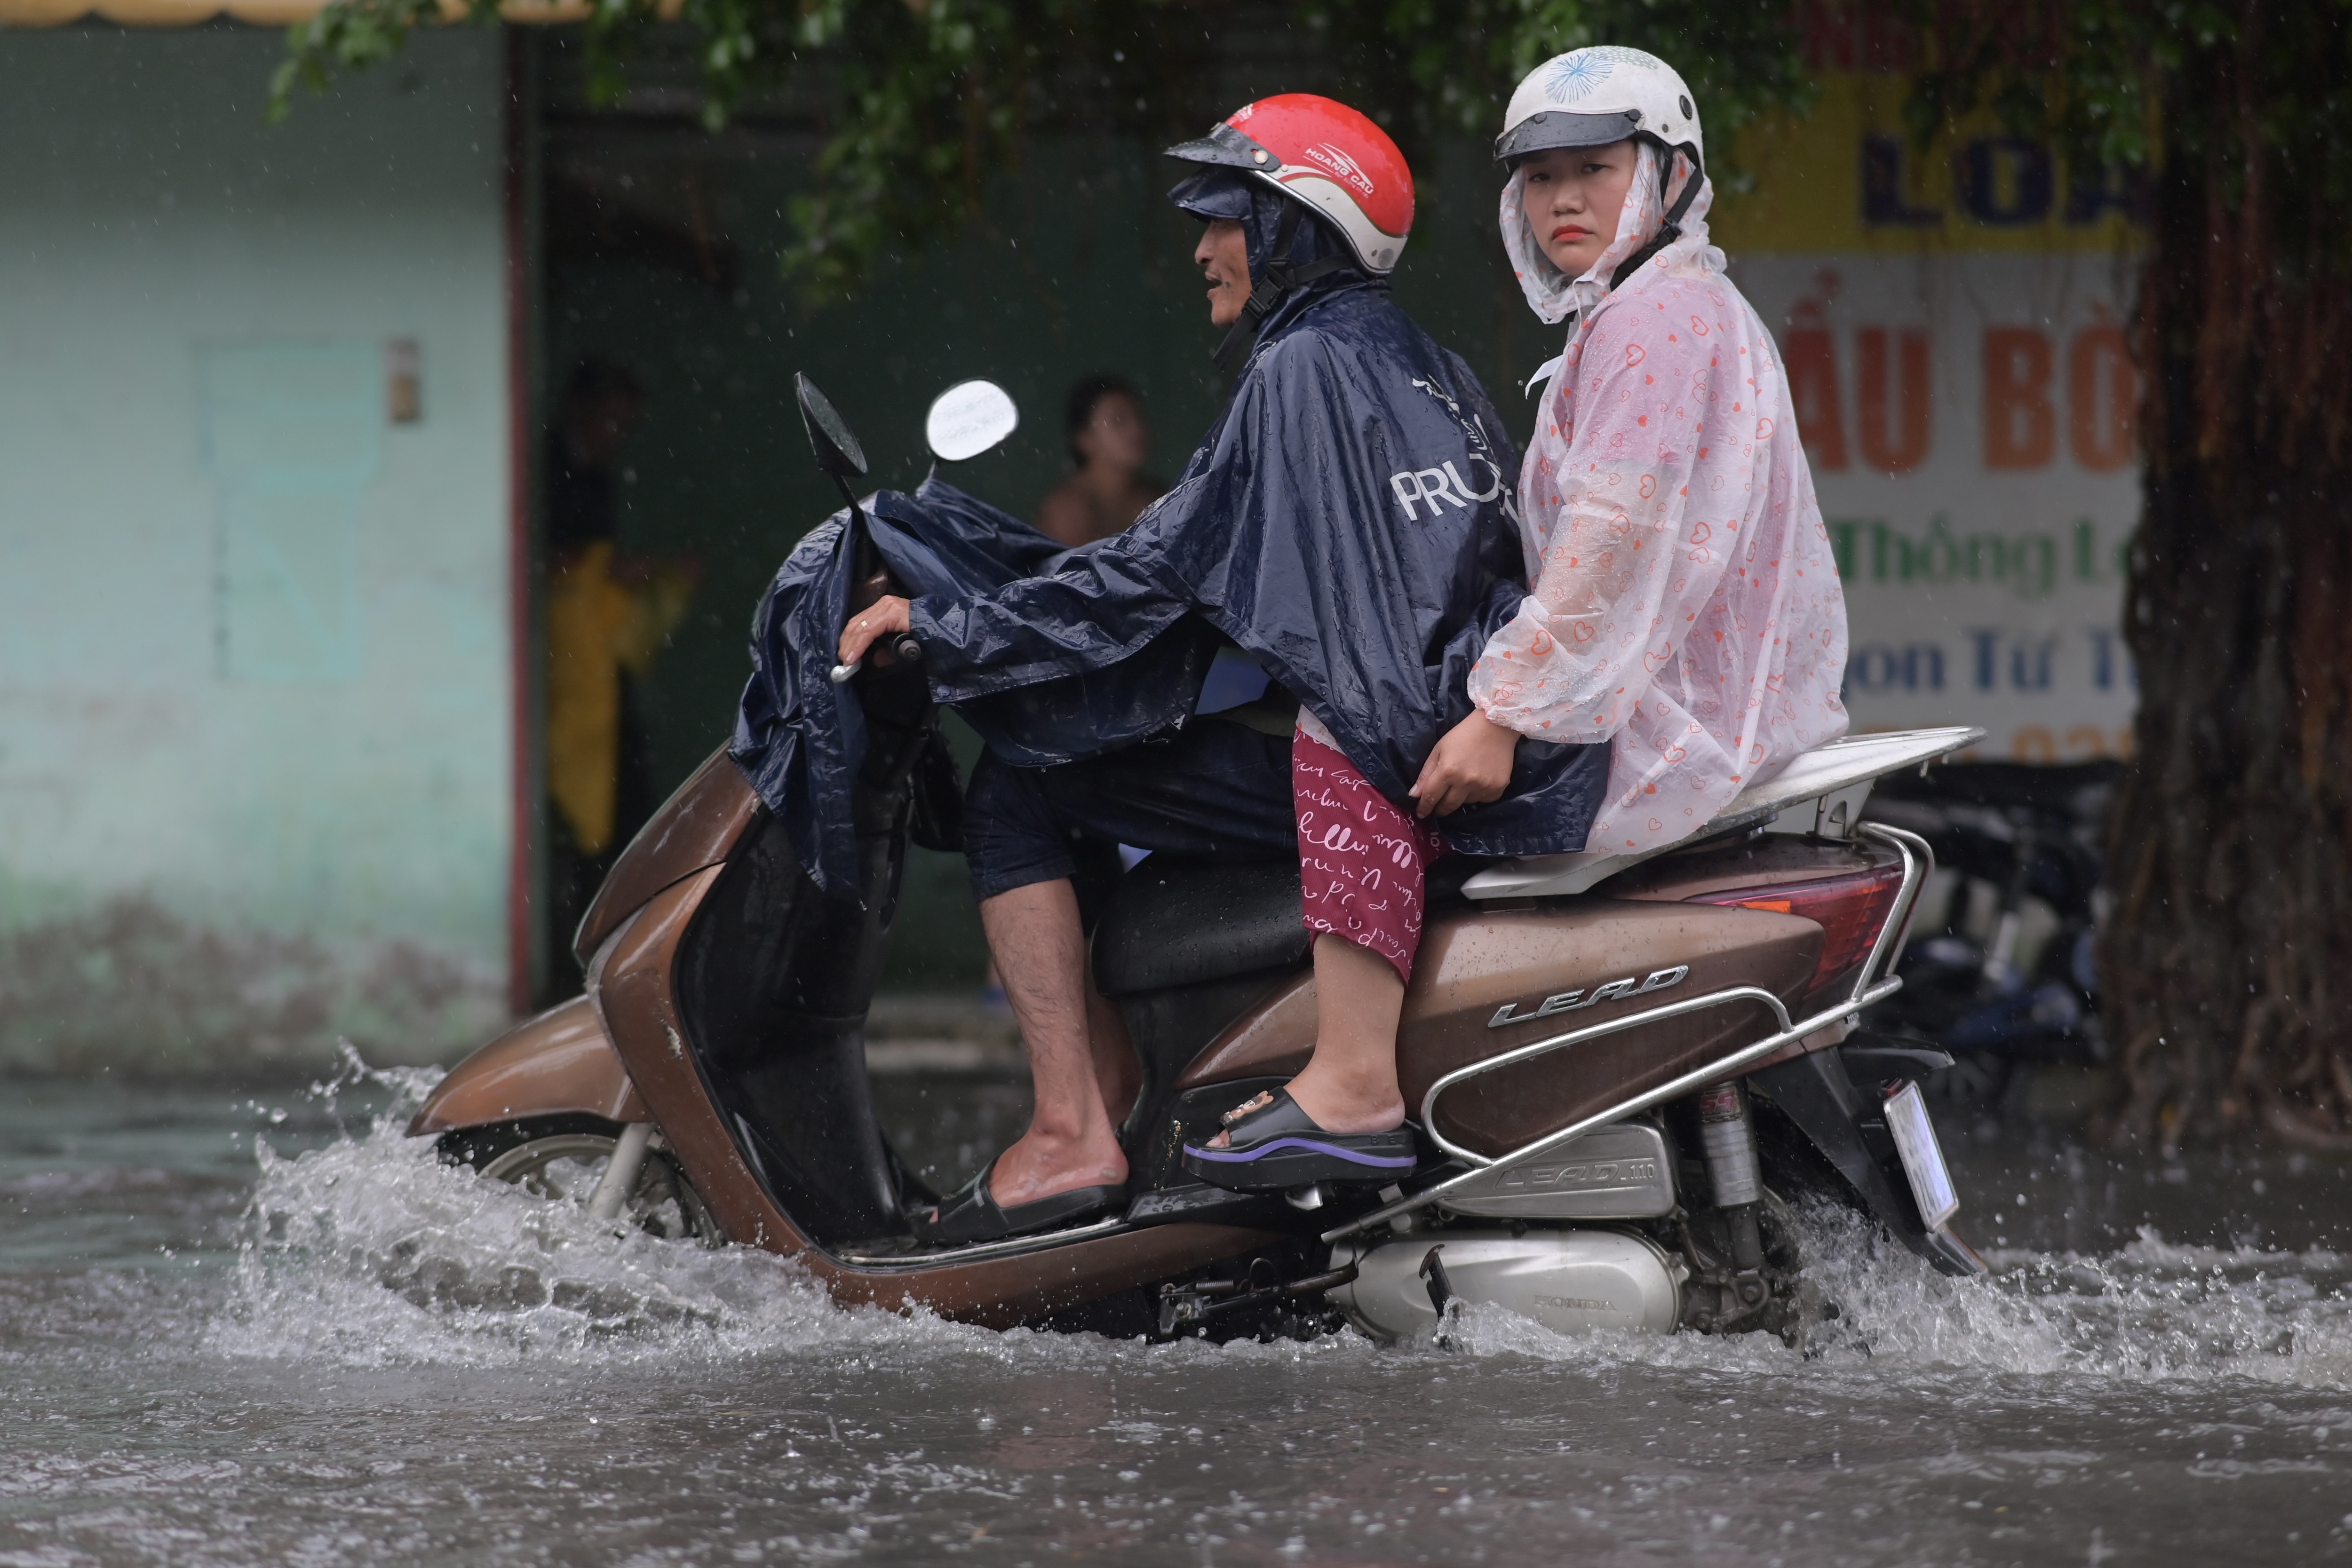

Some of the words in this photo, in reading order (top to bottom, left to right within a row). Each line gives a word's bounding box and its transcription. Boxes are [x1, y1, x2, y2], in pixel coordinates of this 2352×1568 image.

[1305, 148, 1350, 176] HOANG
[1350, 174, 1374, 195] CAU
[1488, 964, 1689, 1028] LEAD
[1534, 1295, 1617, 1311] HONDA
